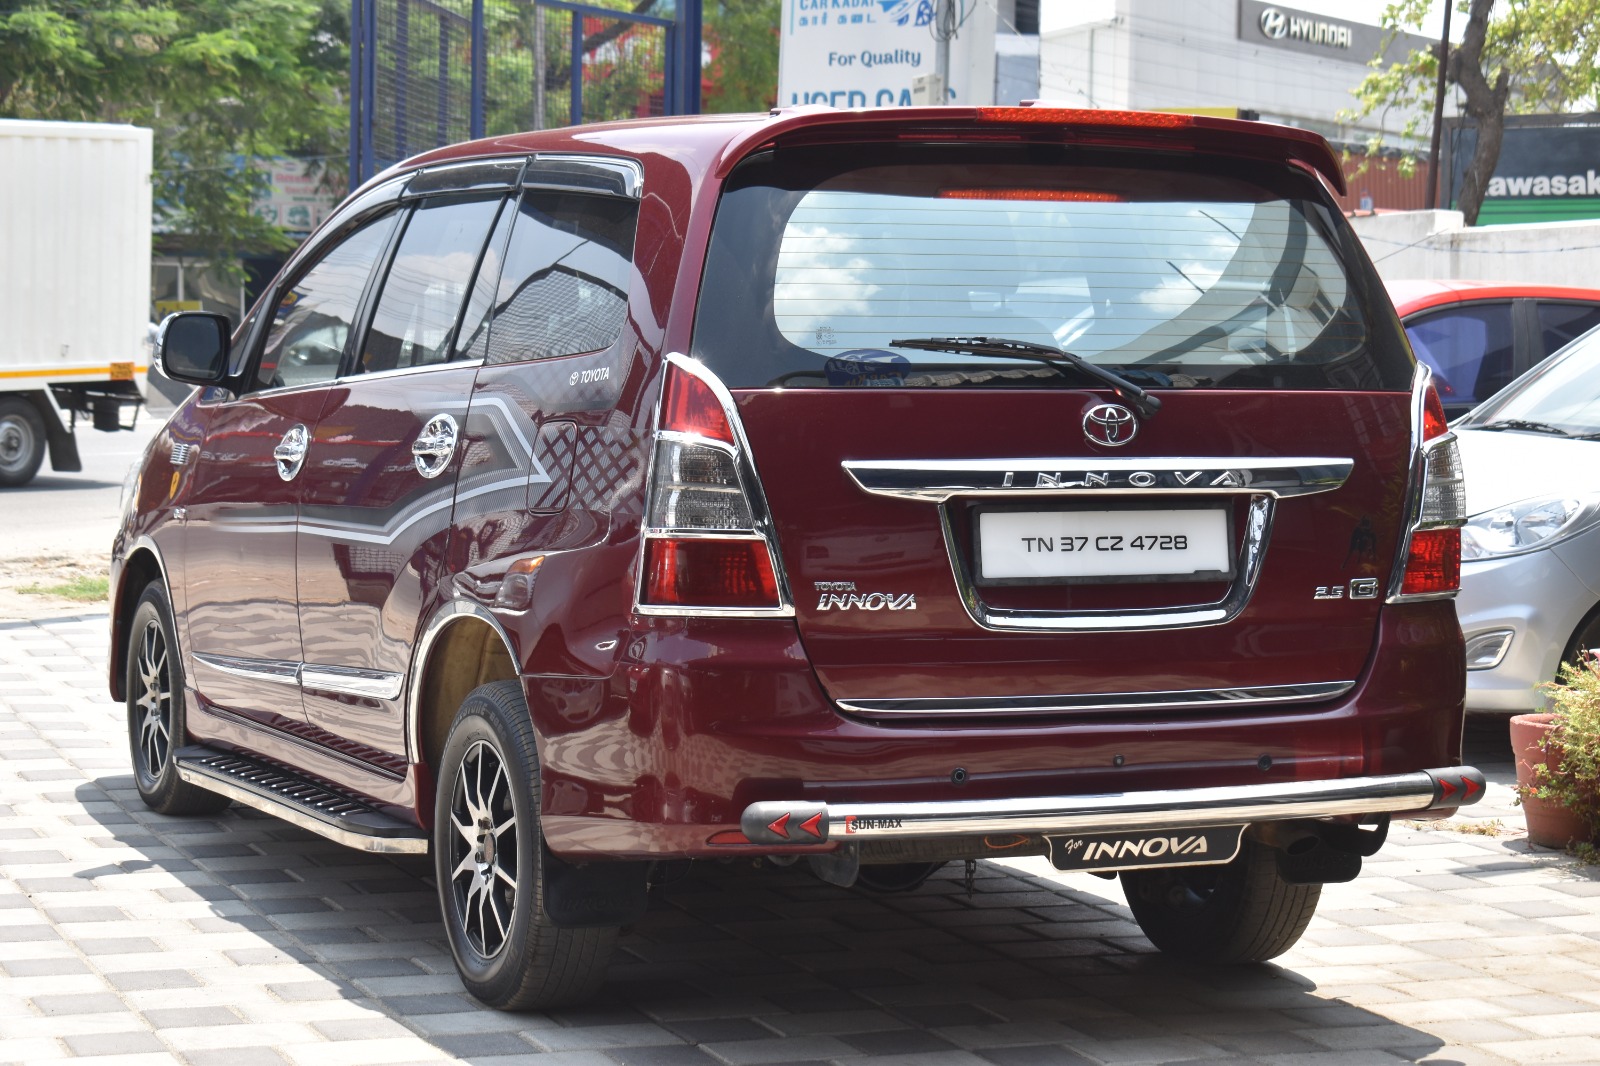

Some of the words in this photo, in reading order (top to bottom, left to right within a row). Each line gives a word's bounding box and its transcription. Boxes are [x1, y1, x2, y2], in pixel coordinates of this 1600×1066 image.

[1289, 16, 1353, 48] HYUNDAI
[828, 52, 856, 67] For
[860, 49, 921, 68] Quality
[1484, 169, 1600, 197] awasak
[580, 366, 610, 384] TOYOTA
[1002, 471, 1239, 488] INNOVA
[1021, 537, 1054, 553] TN
[1060, 536, 1089, 552] 37
[1095, 536, 1124, 552] CZ
[1130, 535, 1188, 551] 4728
[814, 581, 857, 592] TOYOTA
[1313, 586, 1345, 600] 2.5
[1351, 580, 1377, 598] G
[816, 592, 917, 611] INNOVA
[851, 818, 903, 831] SUN-MAX
[1064, 838, 1084, 855] For
[1082, 835, 1208, 861] INNOVA
